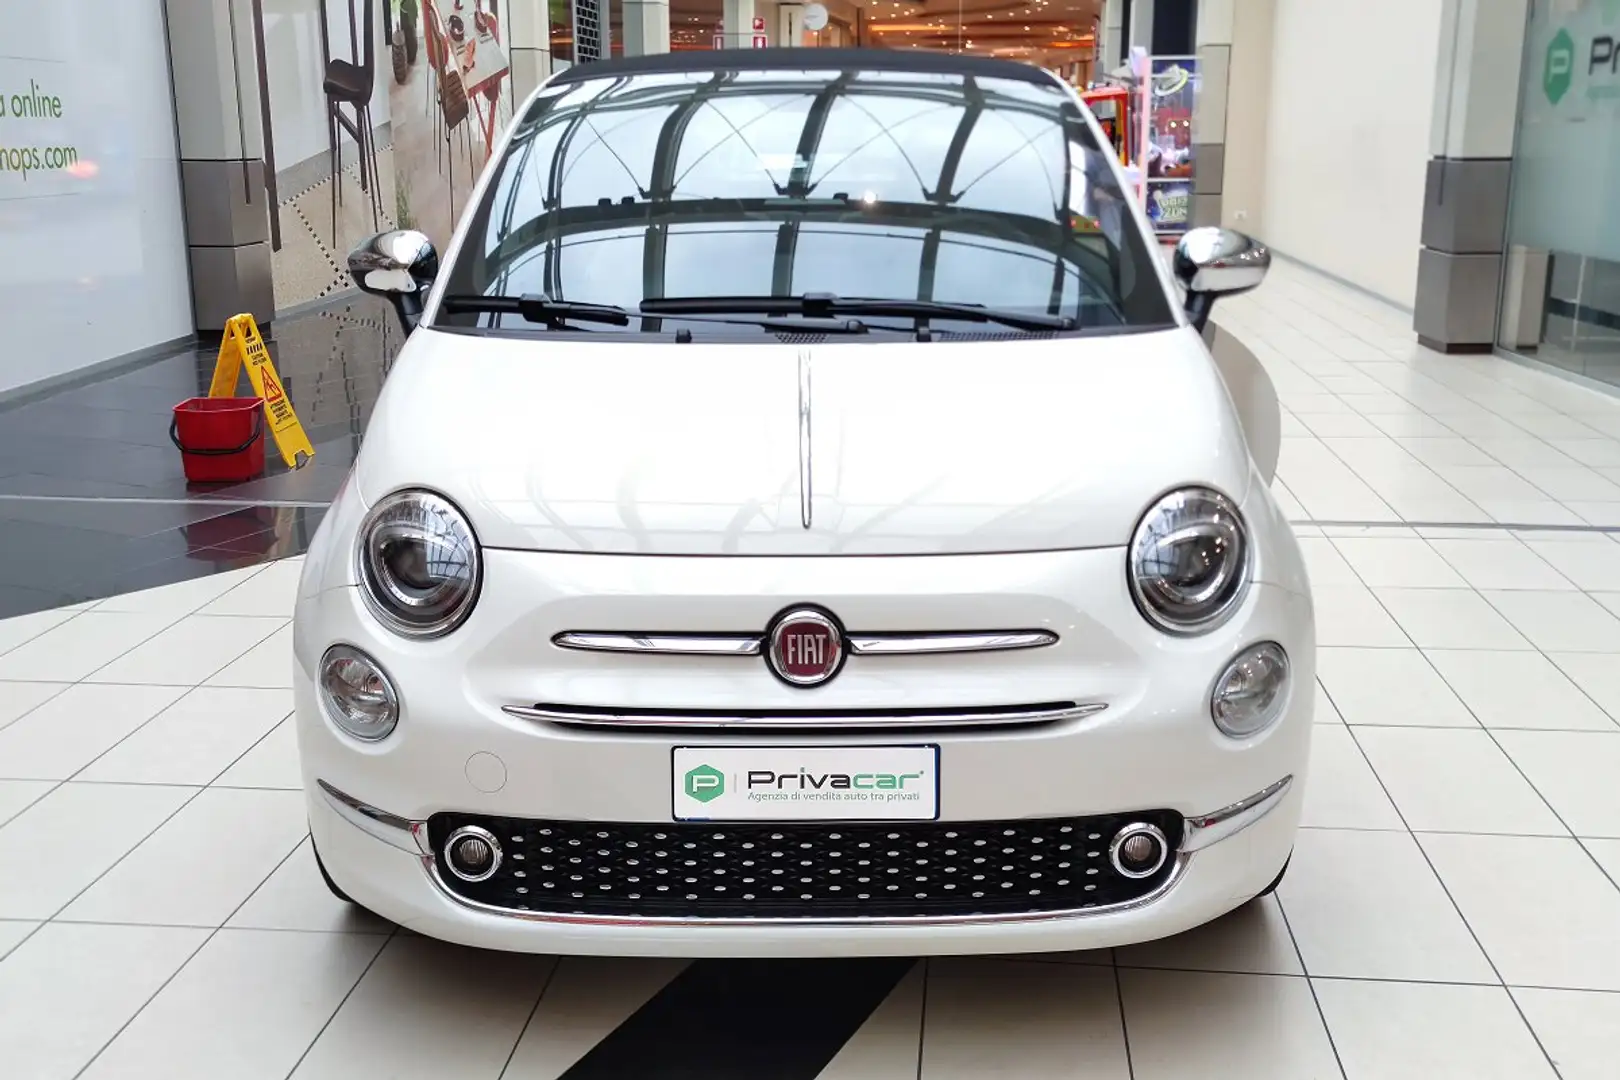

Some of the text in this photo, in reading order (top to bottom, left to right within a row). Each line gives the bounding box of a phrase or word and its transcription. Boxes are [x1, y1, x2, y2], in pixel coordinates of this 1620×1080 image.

[11, 78, 62, 118] online
[787, 633, 827, 665] FIAT
[747, 767, 920, 789] Privacar
[747, 791, 920, 803] Agenzia di vendita auto tra privati
